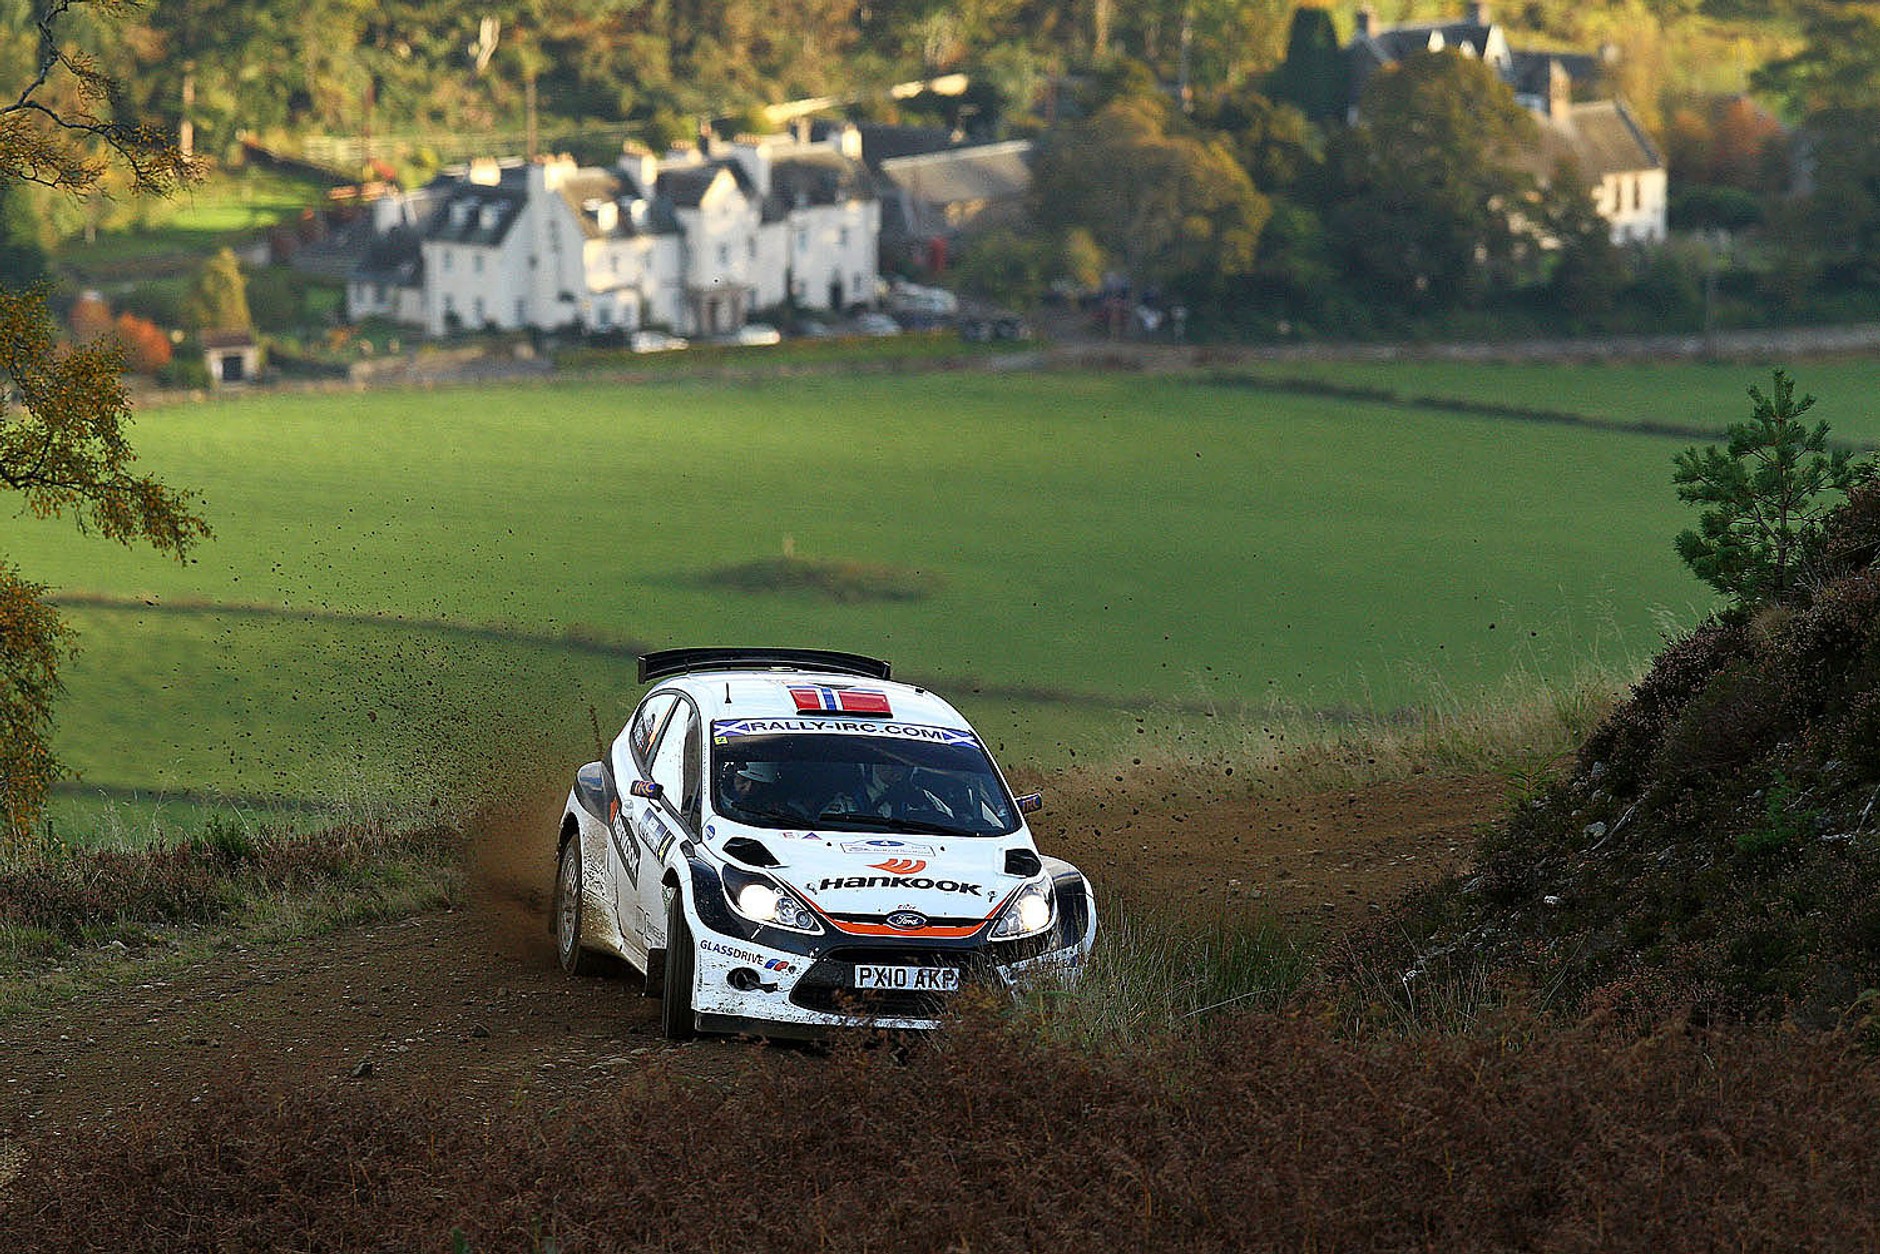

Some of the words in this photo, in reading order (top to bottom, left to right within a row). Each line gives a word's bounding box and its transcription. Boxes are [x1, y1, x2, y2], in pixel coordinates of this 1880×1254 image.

[750, 720, 943, 741] RALLY-IRC.COM
[633, 781, 656, 797] IRC
[896, 914, 919, 925] Ford
[700, 939, 765, 966] GLASSDRIVE
[859, 967, 908, 988] PX10
[914, 968, 955, 989] AKP
